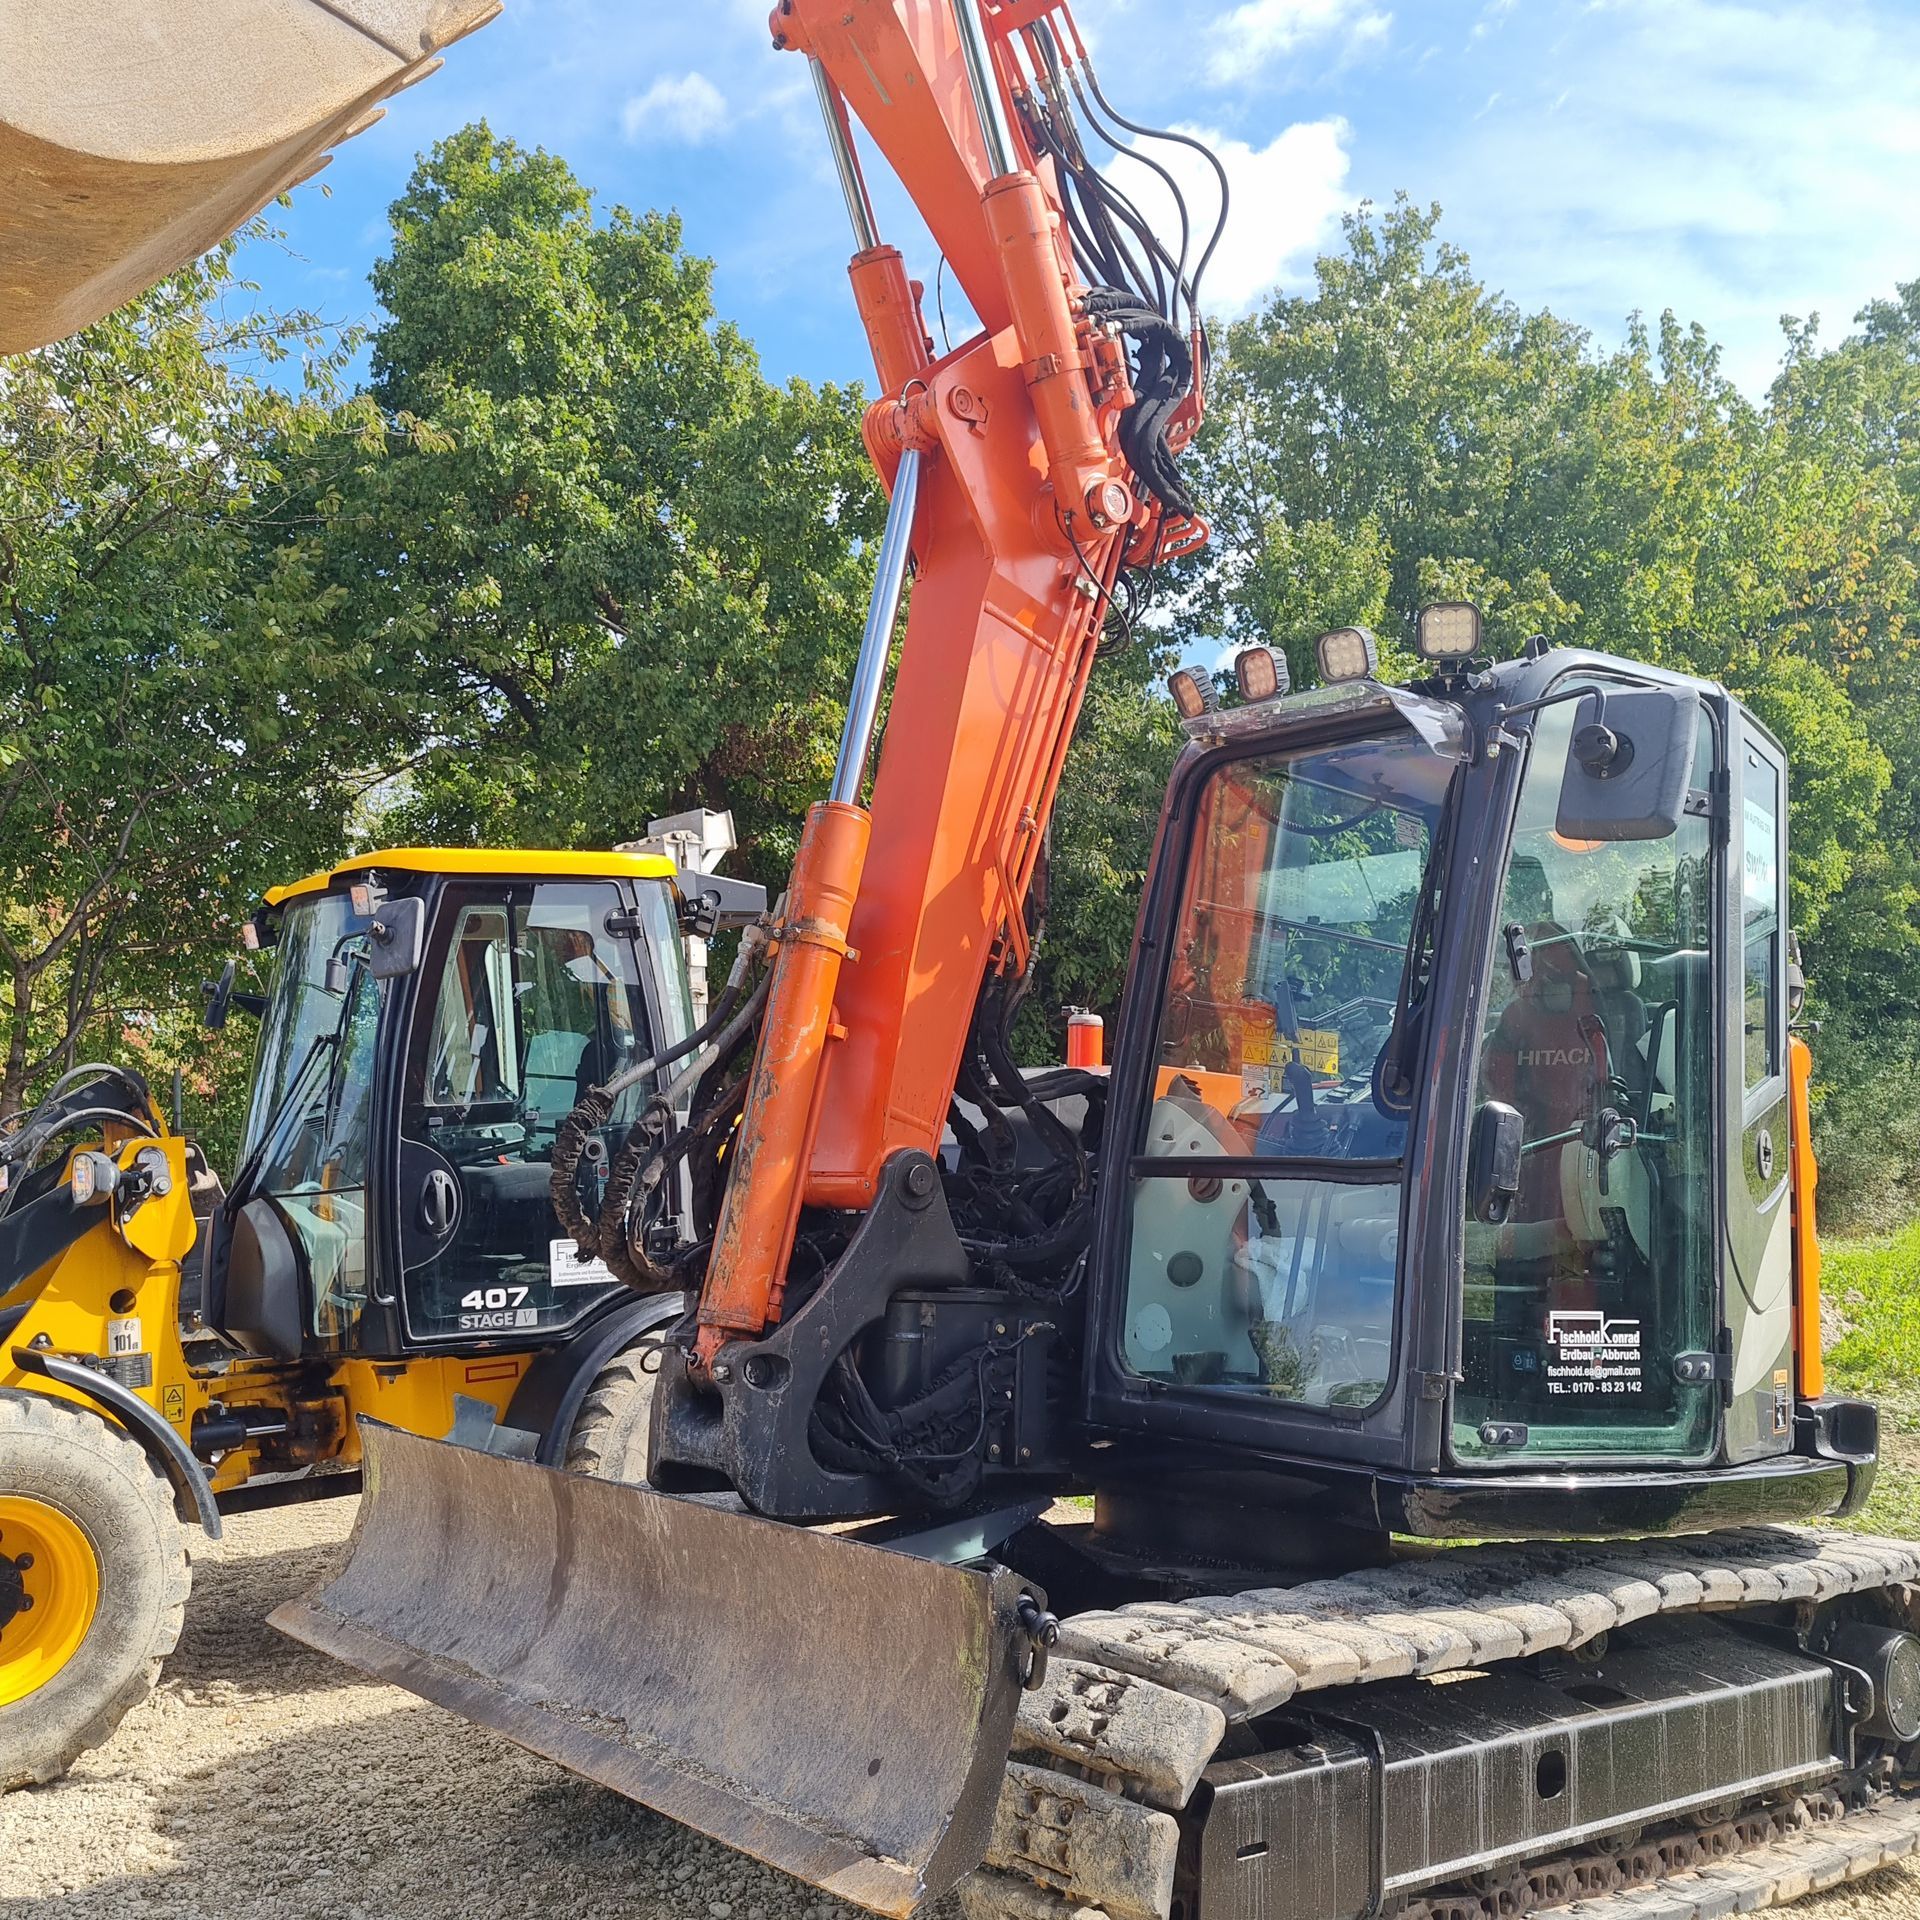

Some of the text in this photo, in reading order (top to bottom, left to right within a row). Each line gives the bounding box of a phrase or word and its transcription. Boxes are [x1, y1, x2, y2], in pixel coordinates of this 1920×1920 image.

[461, 1286, 529, 1310] 407
[461, 1312, 514, 1329] STAGE
[1547, 1310, 1640, 1344] Fischhold Konrad
[114, 1333, 132, 1352] 101
[1560, 1348, 1594, 1361] Erdbau
[1601, 1348, 1641, 1361] Abbruch
[1547, 1365, 1641, 1379] fischhold.ea@gmail.com
[1547, 1382, 1571, 1394] TEL.:
[1572, 1382, 1595, 1393] 0170
[1601, 1381, 1612, 1393] 83
[1614, 1381, 1625, 1393] 23
[1627, 1381, 1642, 1393] 142
